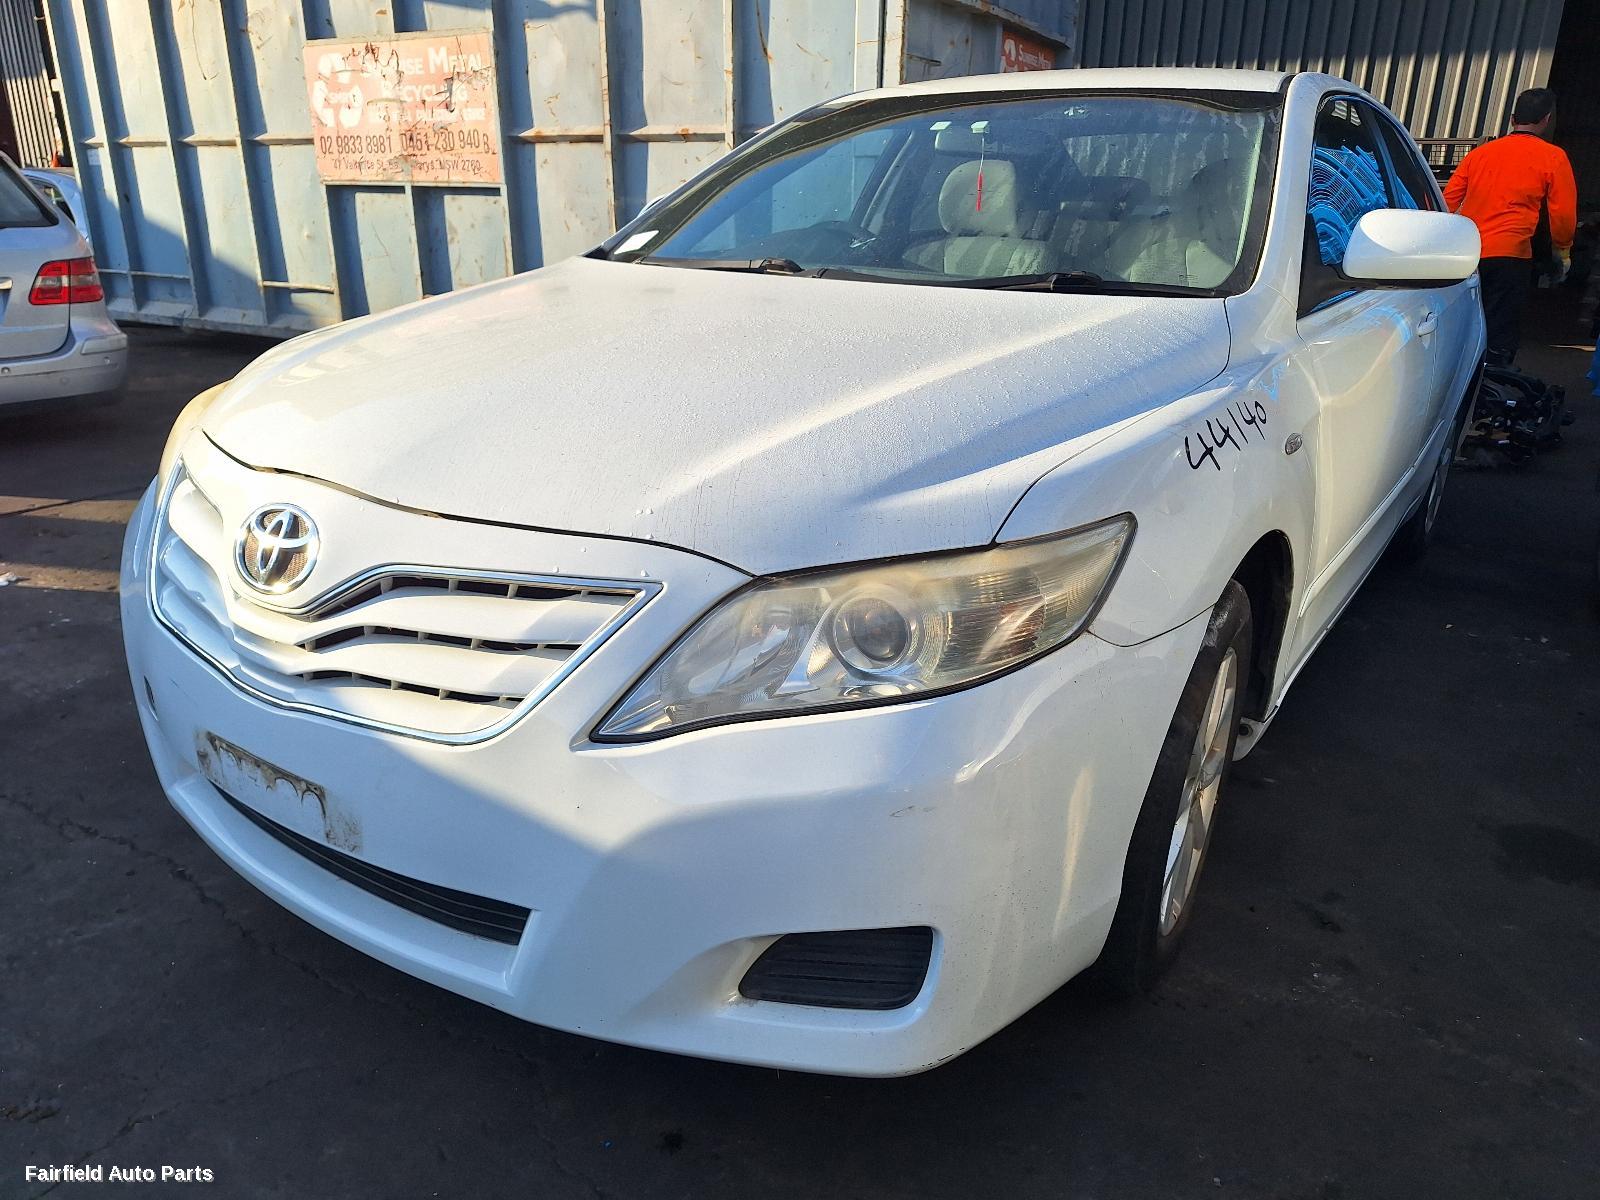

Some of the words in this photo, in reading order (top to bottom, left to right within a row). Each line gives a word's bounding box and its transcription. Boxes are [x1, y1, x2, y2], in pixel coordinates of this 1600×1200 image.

[319, 136, 334, 155] 02
[336, 135, 363, 154] 9833
[365, 134, 392, 154] 8981
[433, 131, 455, 150] 230
[458, 129, 480, 149] 940
